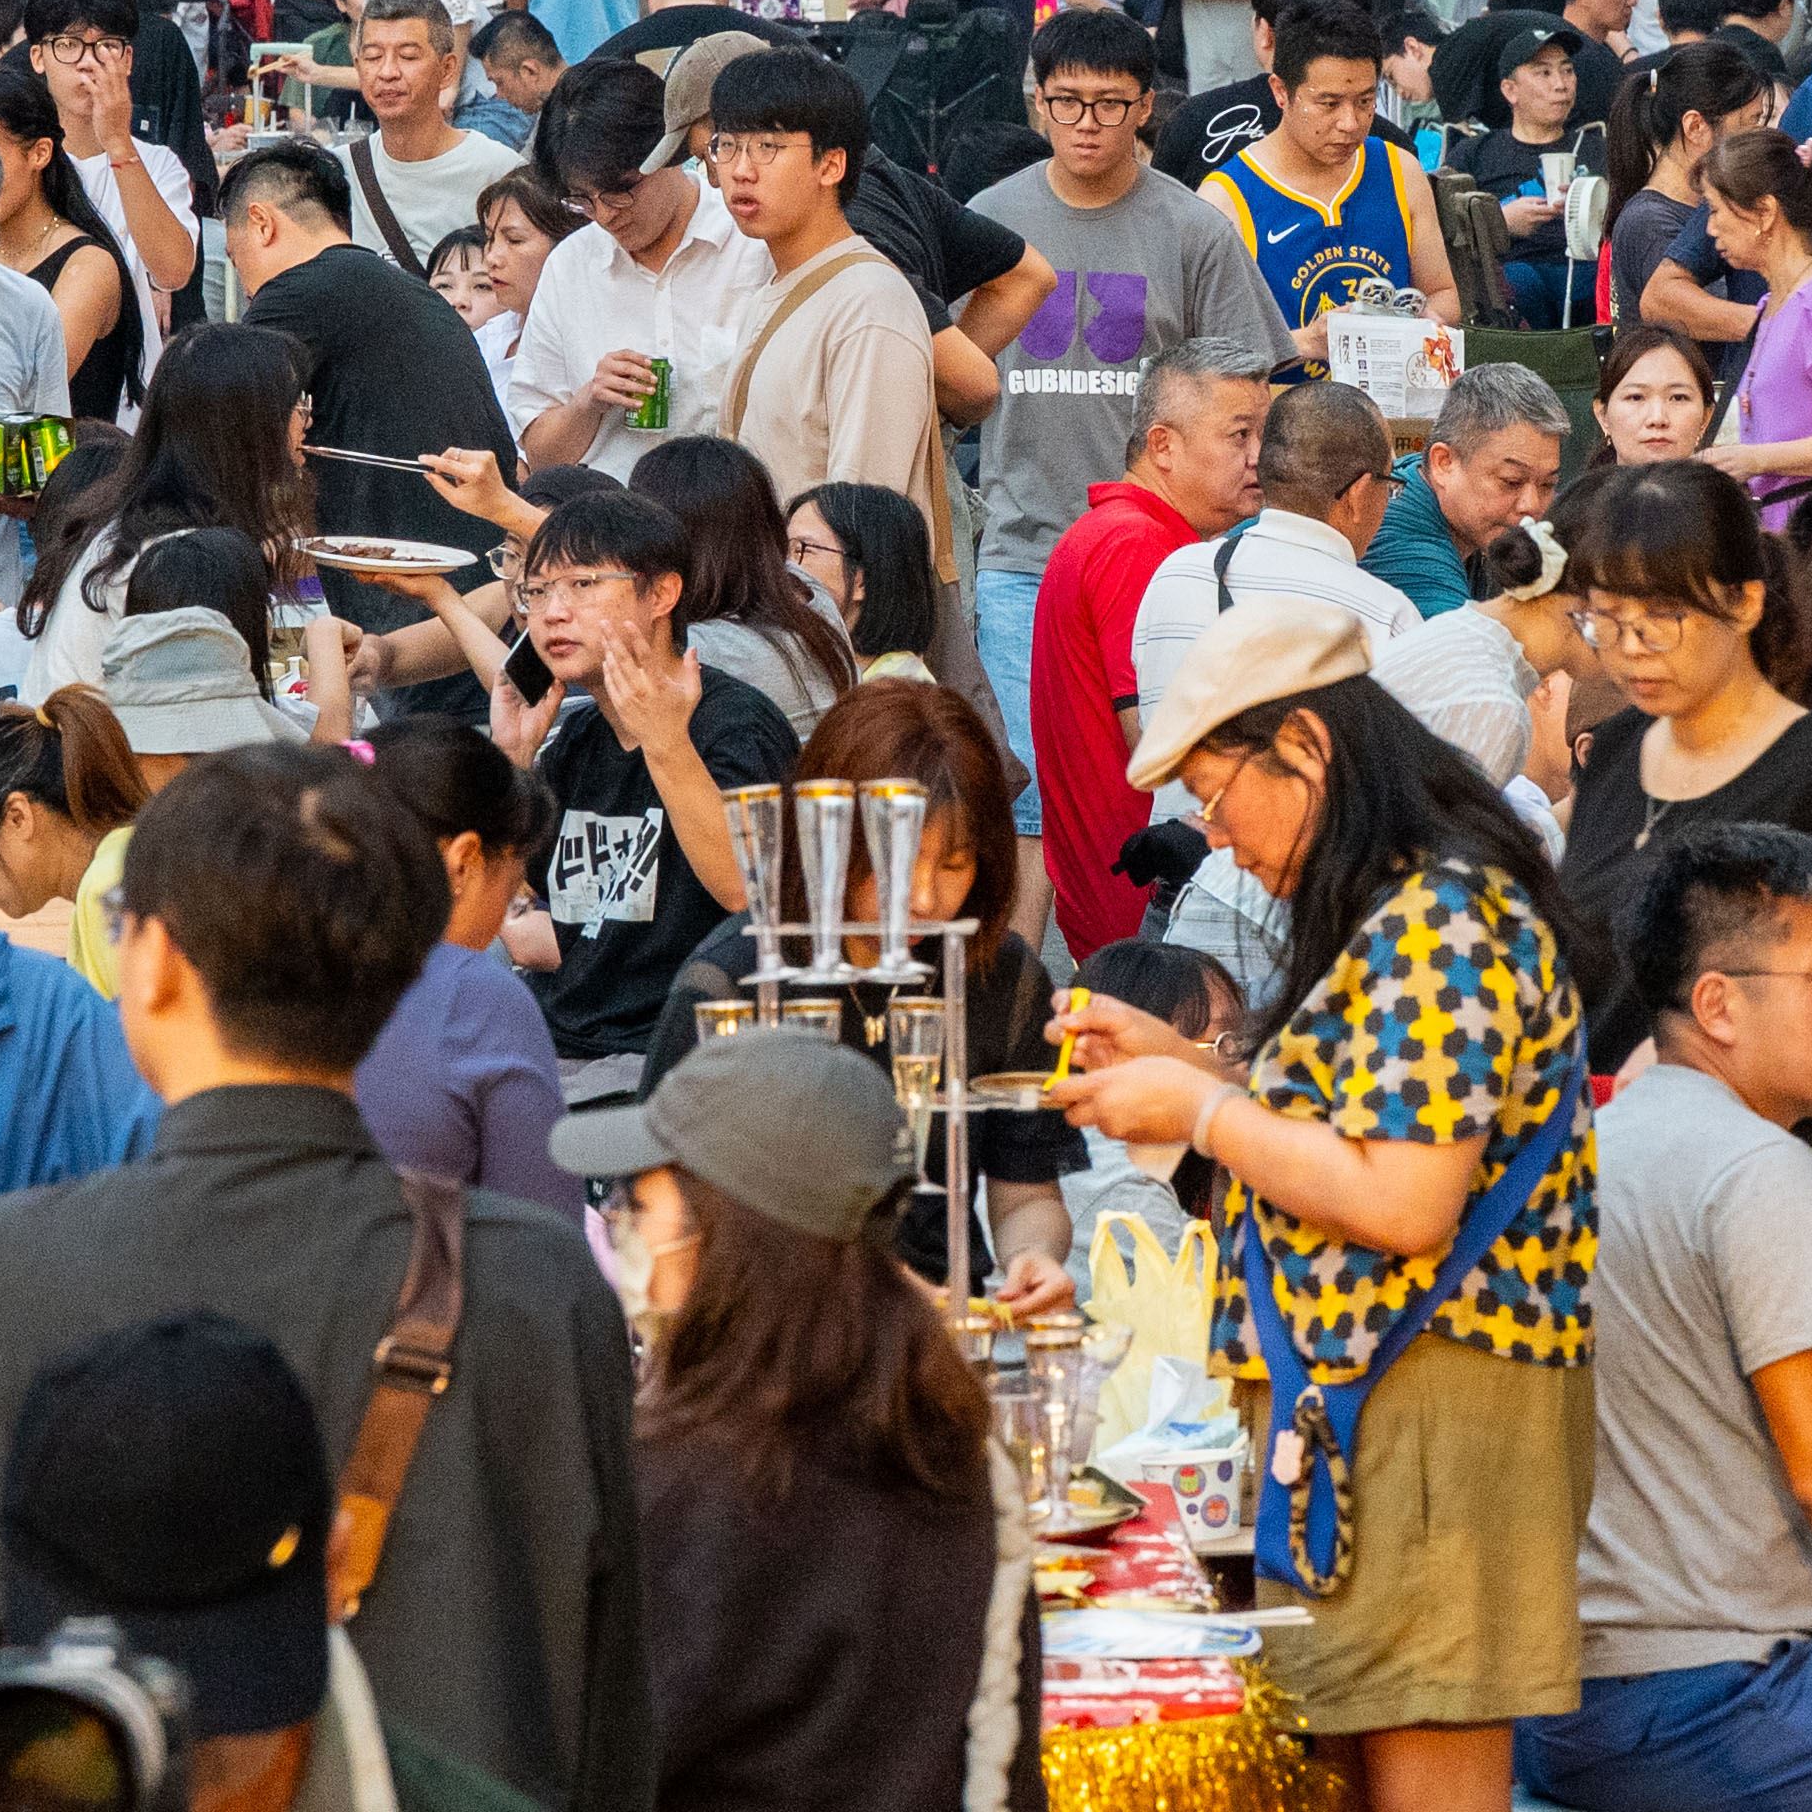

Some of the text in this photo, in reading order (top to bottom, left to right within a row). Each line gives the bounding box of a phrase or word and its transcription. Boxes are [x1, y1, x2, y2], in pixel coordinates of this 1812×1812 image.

[1291, 245, 1392, 290] GOLDEN STATE
[1008, 368, 1140, 396] GUBNDESIG
